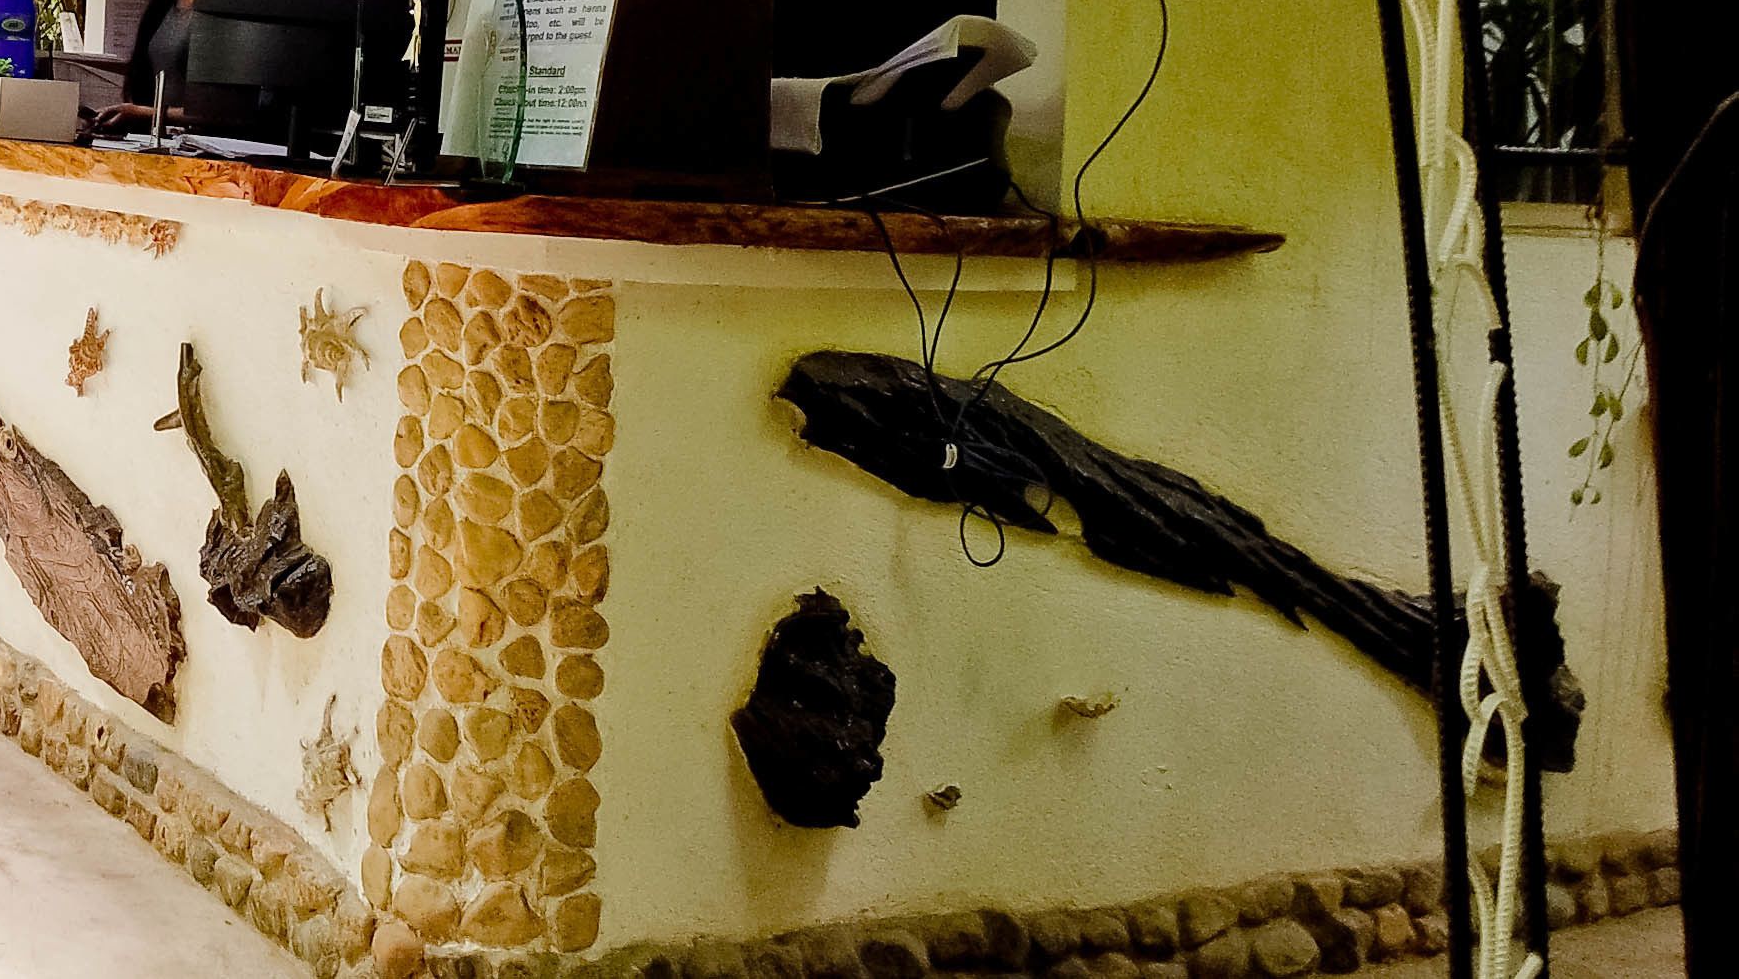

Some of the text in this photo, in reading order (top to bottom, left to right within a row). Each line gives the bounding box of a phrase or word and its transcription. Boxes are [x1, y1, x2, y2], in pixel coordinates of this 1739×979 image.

[545, 6, 563, 15] such
[582, 5, 607, 13] henna
[572, 17, 586, 26] will
[594, 17, 604, 26] be
[546, 32, 554, 40] to
[555, 31, 567, 40] the
[528, 65, 566, 77] Standard
[537, 85, 557, 94] time:
